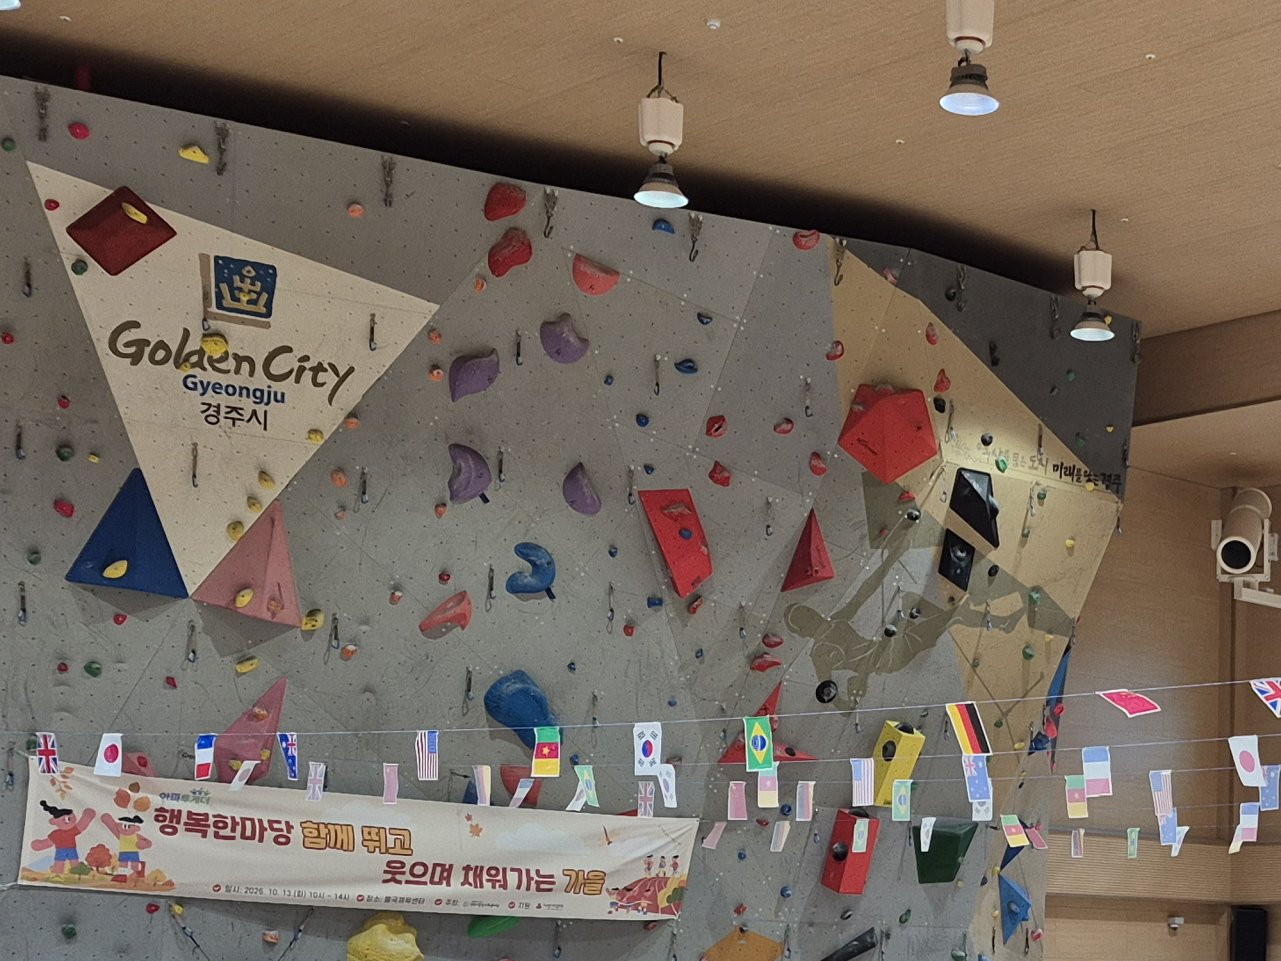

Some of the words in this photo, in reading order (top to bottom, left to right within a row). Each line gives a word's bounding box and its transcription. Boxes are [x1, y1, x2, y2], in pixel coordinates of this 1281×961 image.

[182, 374, 286, 405] Gyeongju
[262, 345, 355, 406] City
[200, 401, 269, 432] 경주시
[1052, 461, 1082, 483] 미래를
[153, 805, 295, 846] 행복한마당
[300, 819, 356, 853] 함께
[361, 825, 414, 857] 뛰고
[381, 859, 454, 888] 웃으며
[460, 863, 557, 893] 채워가는
[562, 868, 608, 896] 가을
